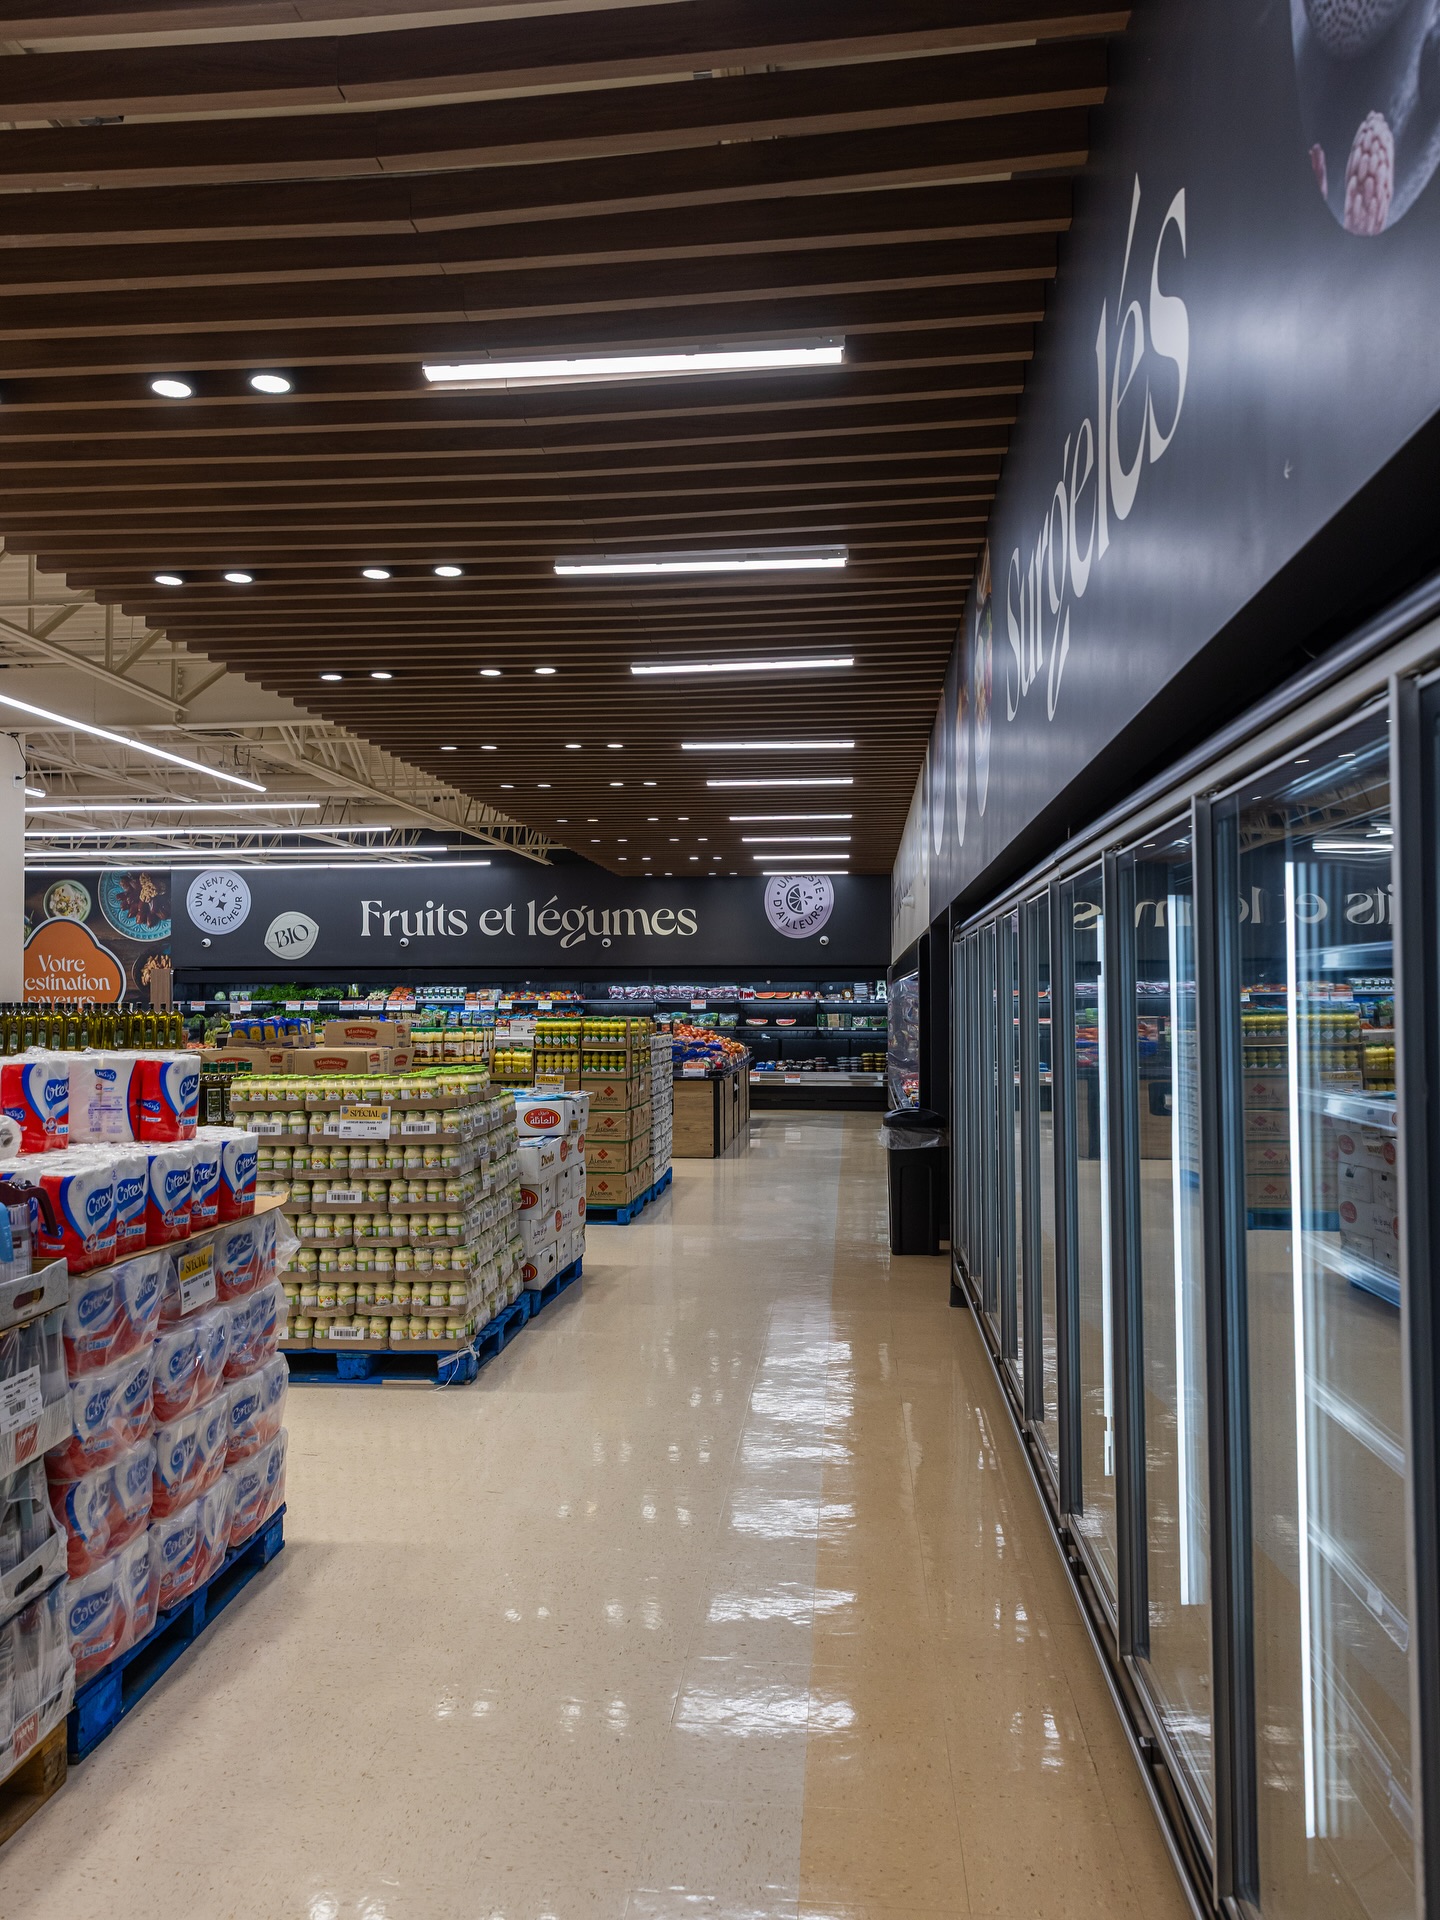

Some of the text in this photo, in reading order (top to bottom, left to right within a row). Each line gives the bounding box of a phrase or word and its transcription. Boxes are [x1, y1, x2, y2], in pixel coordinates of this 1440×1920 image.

[1007, 172, 1189, 721] Surgelés
[195, 877, 239, 907] UN VENT DE
[199, 896, 243, 926] FRAÎCHEUR
[360, 895, 698, 949] Fruits et légumes
[773, 899, 824, 930] D'AILLEURS
[274, 924, 309, 948] BIO
[38, 954, 86, 973] Votre
[24, 973, 111, 991] estination
[350, 1107, 380, 1118] SPÉCIAL
[70, 1591, 110, 1628] Cotex
